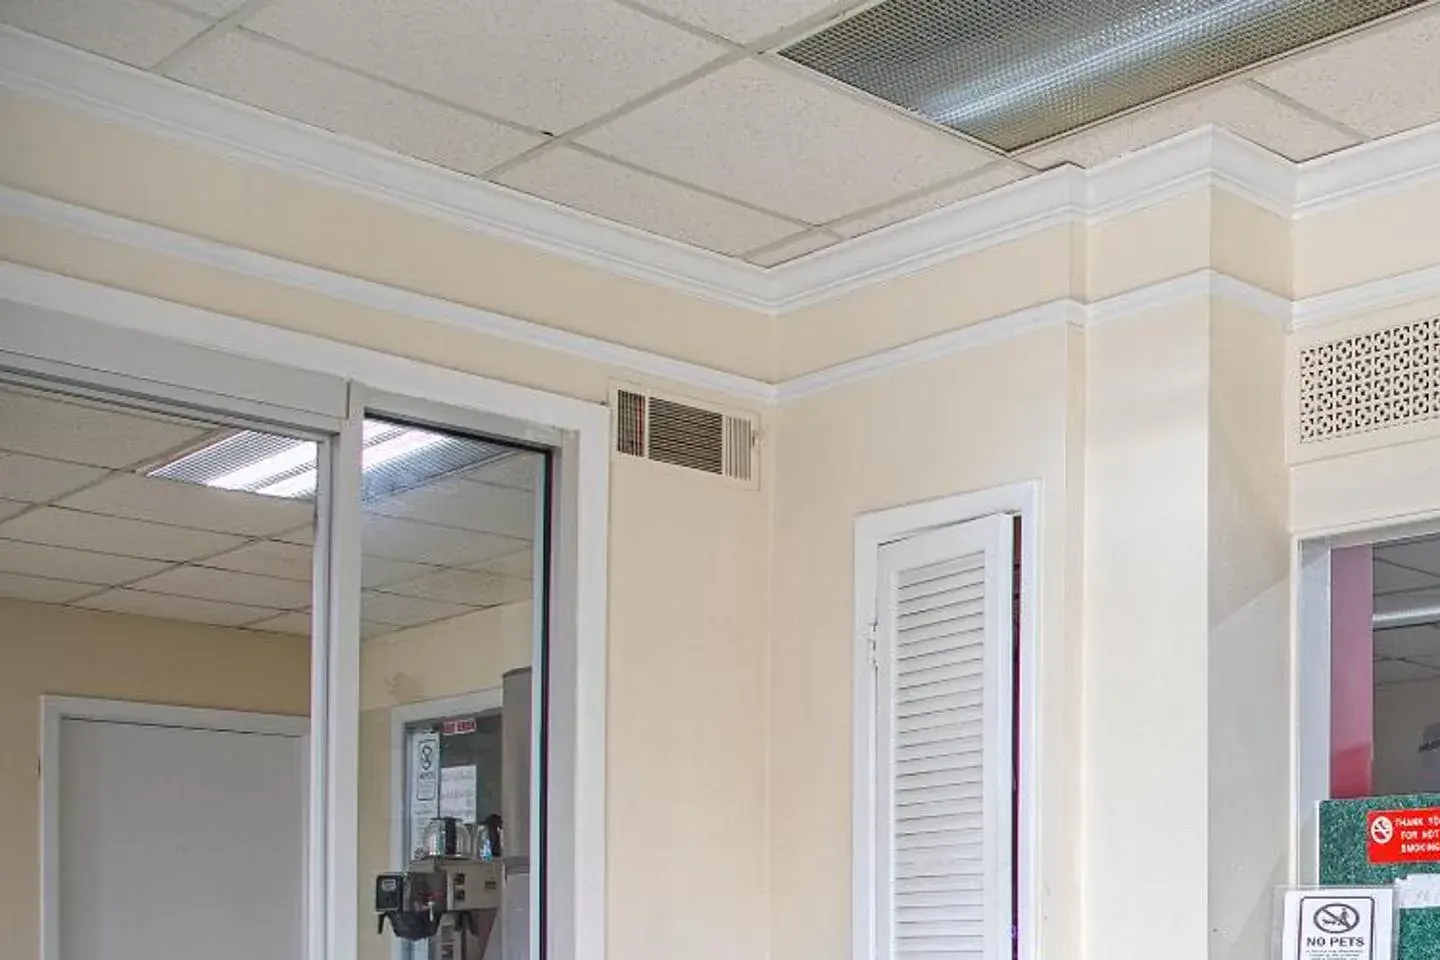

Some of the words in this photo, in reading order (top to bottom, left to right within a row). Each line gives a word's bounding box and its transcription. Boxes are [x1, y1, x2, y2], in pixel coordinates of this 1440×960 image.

[1394, 817, 1424, 828] THANK
[1401, 830, 1418, 840] FOR
[1422, 829, 1440, 840] NOT
[1401, 843, 1440, 854] SMOKING
[1307, 936, 1326, 947] NO
[1329, 936, 1364, 948] PETS
